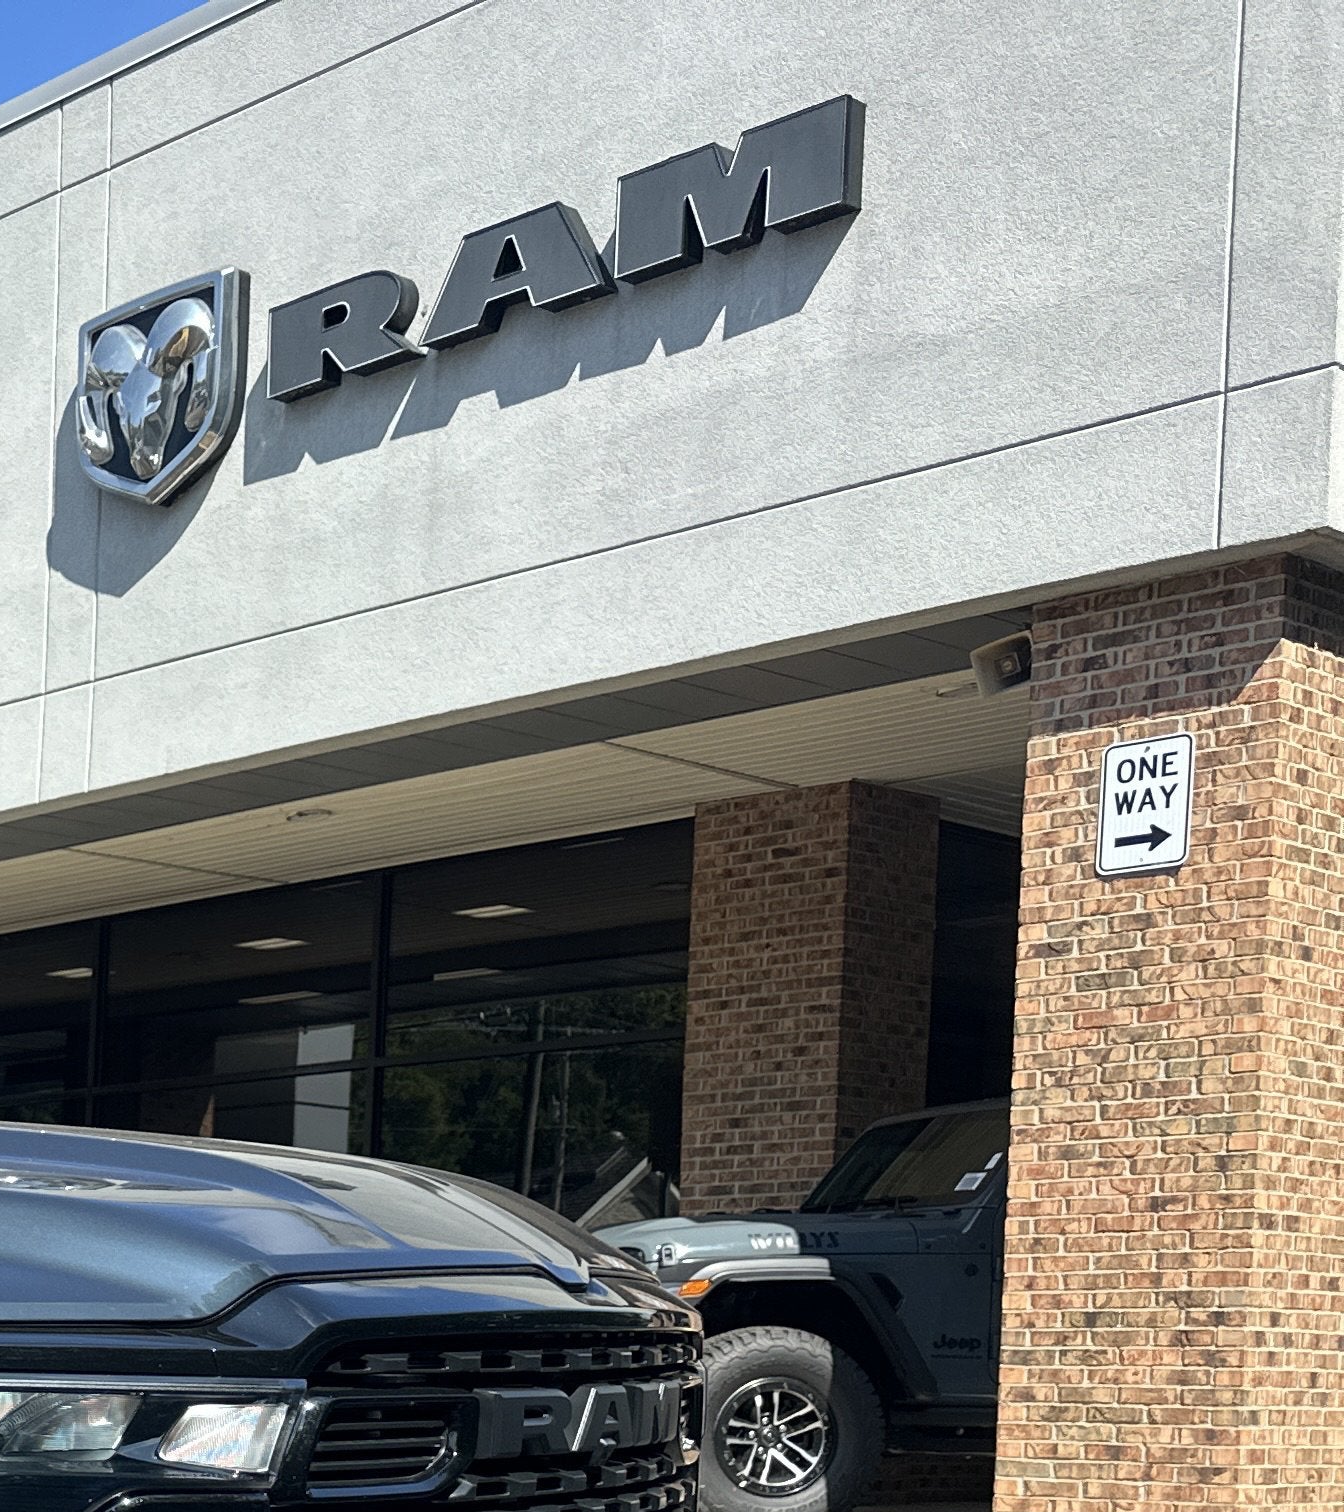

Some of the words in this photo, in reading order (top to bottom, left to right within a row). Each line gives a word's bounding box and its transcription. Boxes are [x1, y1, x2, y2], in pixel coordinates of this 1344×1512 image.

[266, 94, 866, 402] RAM
[1116, 751, 1179, 784] ONE
[1114, 783, 1179, 816] WAY
[472, 1379, 681, 1460] RAM
